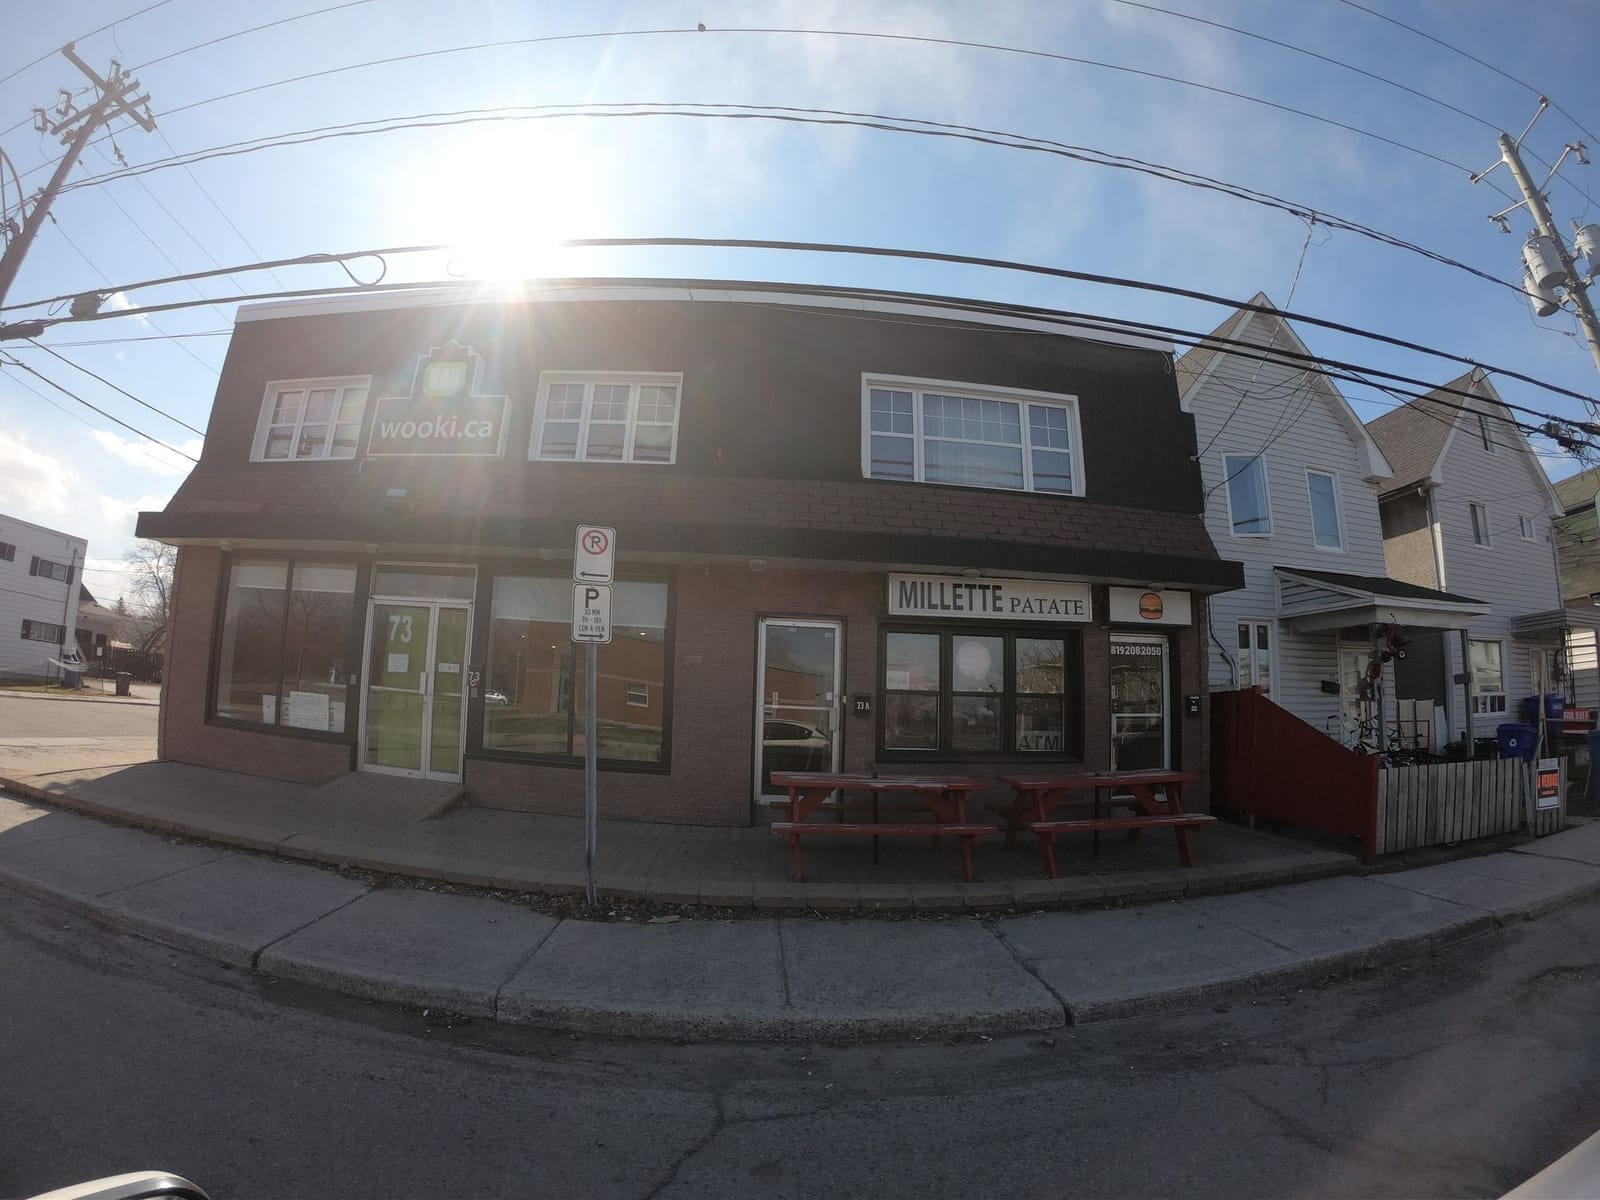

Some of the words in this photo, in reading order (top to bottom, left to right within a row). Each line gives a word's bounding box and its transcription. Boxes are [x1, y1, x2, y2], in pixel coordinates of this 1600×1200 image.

[381, 414, 493, 438] wooki.ca
[586, 588, 599, 608] P
[898, 580, 1003, 612] MILLETTE
[1009, 596, 1084, 615] PATATE
[389, 614, 413, 643] 73
[1110, 645, 1162, 656] 8192082050
[468, 671, 480, 681] 73
[1018, 735, 1060, 750] ATM
